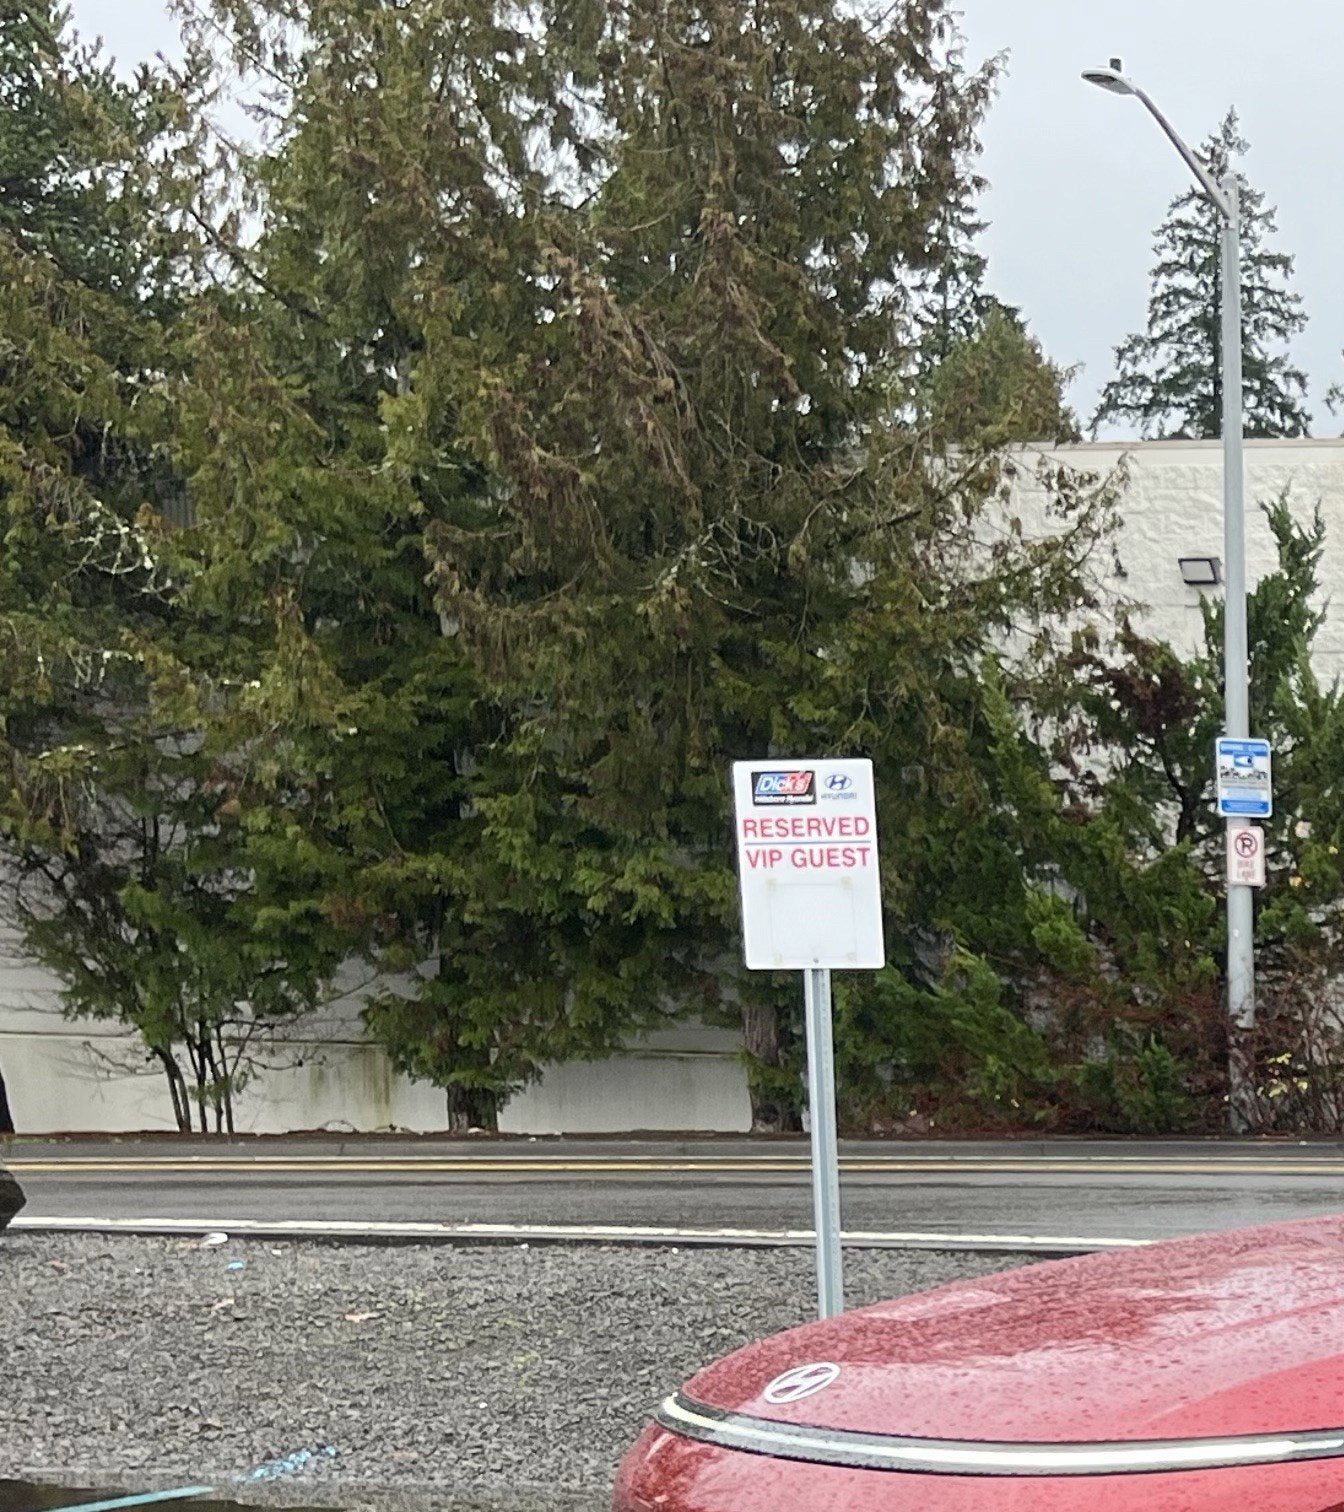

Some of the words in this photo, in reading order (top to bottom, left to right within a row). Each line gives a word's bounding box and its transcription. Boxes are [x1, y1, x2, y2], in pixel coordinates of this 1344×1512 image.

[742, 816, 870, 838] RESERVED
[745, 848, 783, 869] VIP
[790, 846, 871, 869] GUEST
